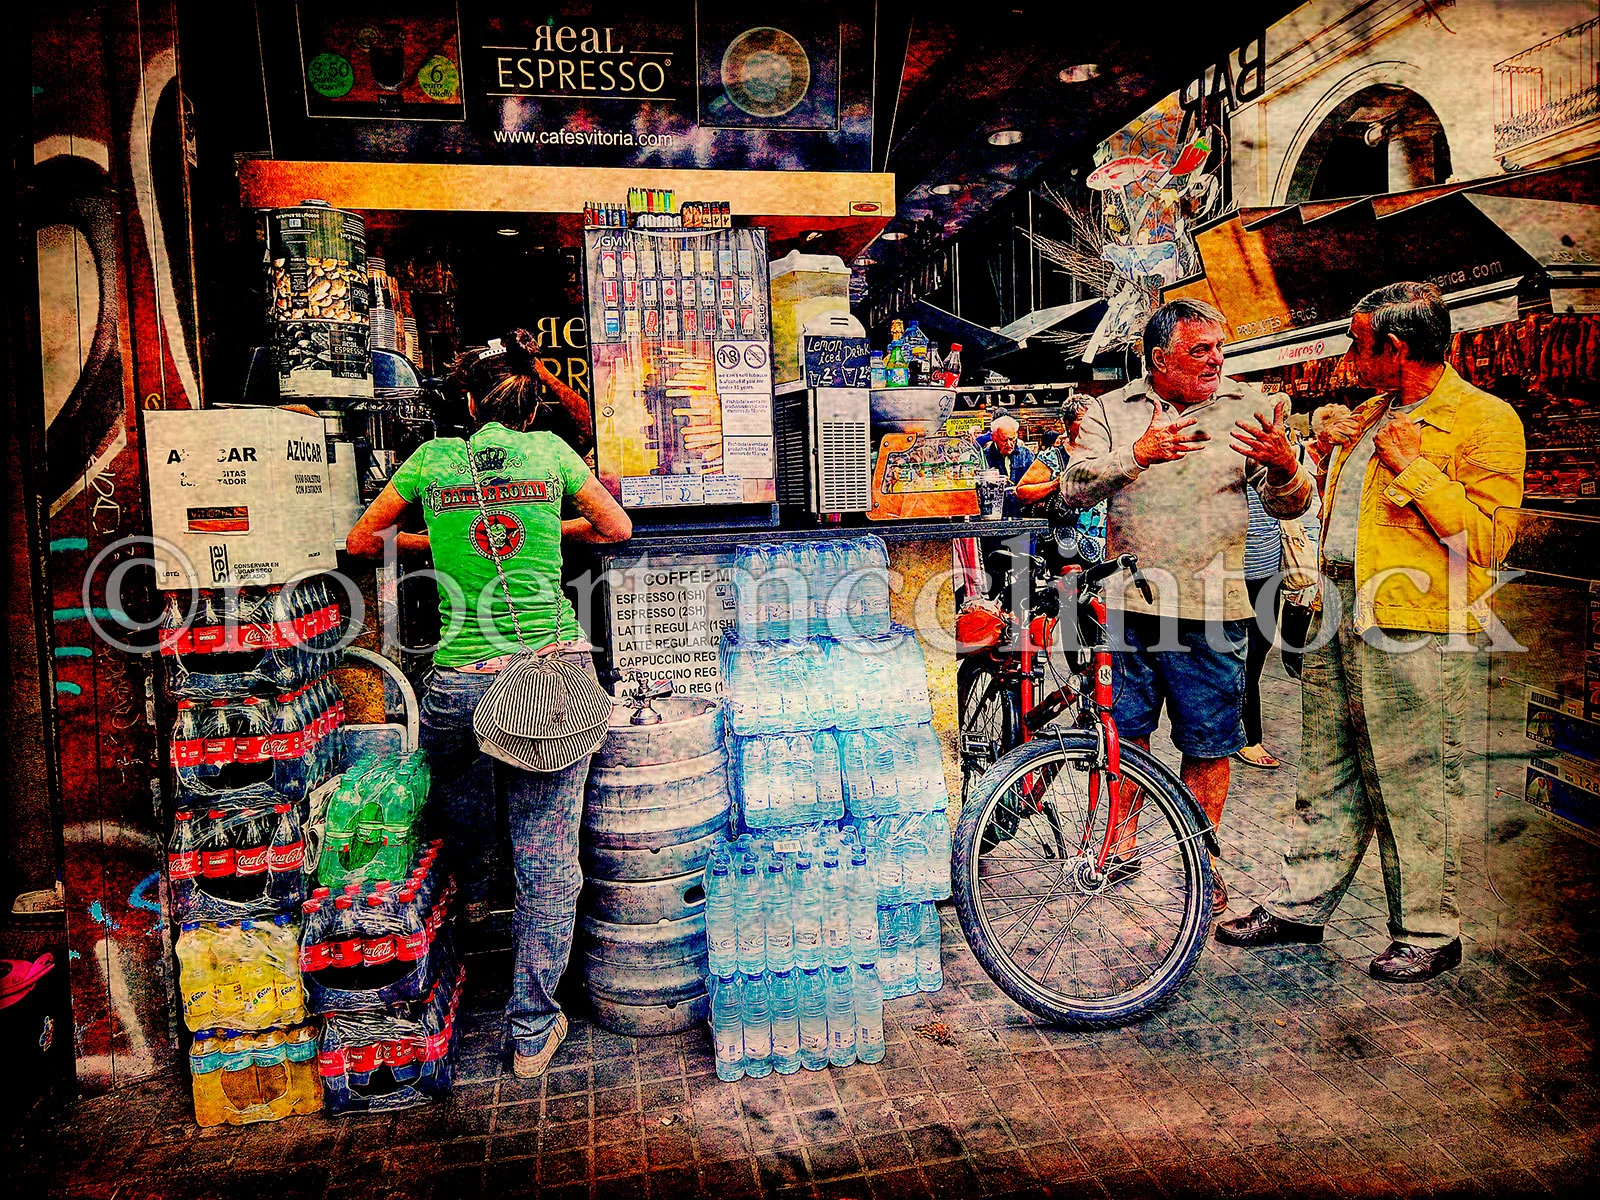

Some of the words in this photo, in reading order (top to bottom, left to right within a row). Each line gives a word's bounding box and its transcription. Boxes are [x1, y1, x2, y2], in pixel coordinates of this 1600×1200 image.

[430, 64, 443, 83] 6
[498, 57, 665, 92] ESPRESSO
[494, 128, 673, 147] www.cafesvitoria.com
[807, 337, 842, 352] Lemon
[1278, 344, 1314, 360] Marcos
[818, 351, 842, 365] iced
[287, 436, 322, 463] AZÚCAR
[499, 484, 544, 498] ROYAL
[643, 569, 711, 586] COFFEE
[616, 591, 675, 605] ESPRESSO
[678, 590, 706, 604] (1SH)
[617, 607, 676, 620] ESPRESSO
[678, 606, 707, 620] (2SH)
[618, 624, 651, 637] LATTE
[654, 621, 707, 634] REGULAR
[618, 640, 652, 652] LATTE
[655, 637, 708, 649] REGULAR
[619, 653, 691, 668] CAPPUCCINO
[694, 652, 717, 663] REG
[694, 667, 717, 678] REG
[689, 685, 712, 694] REG
